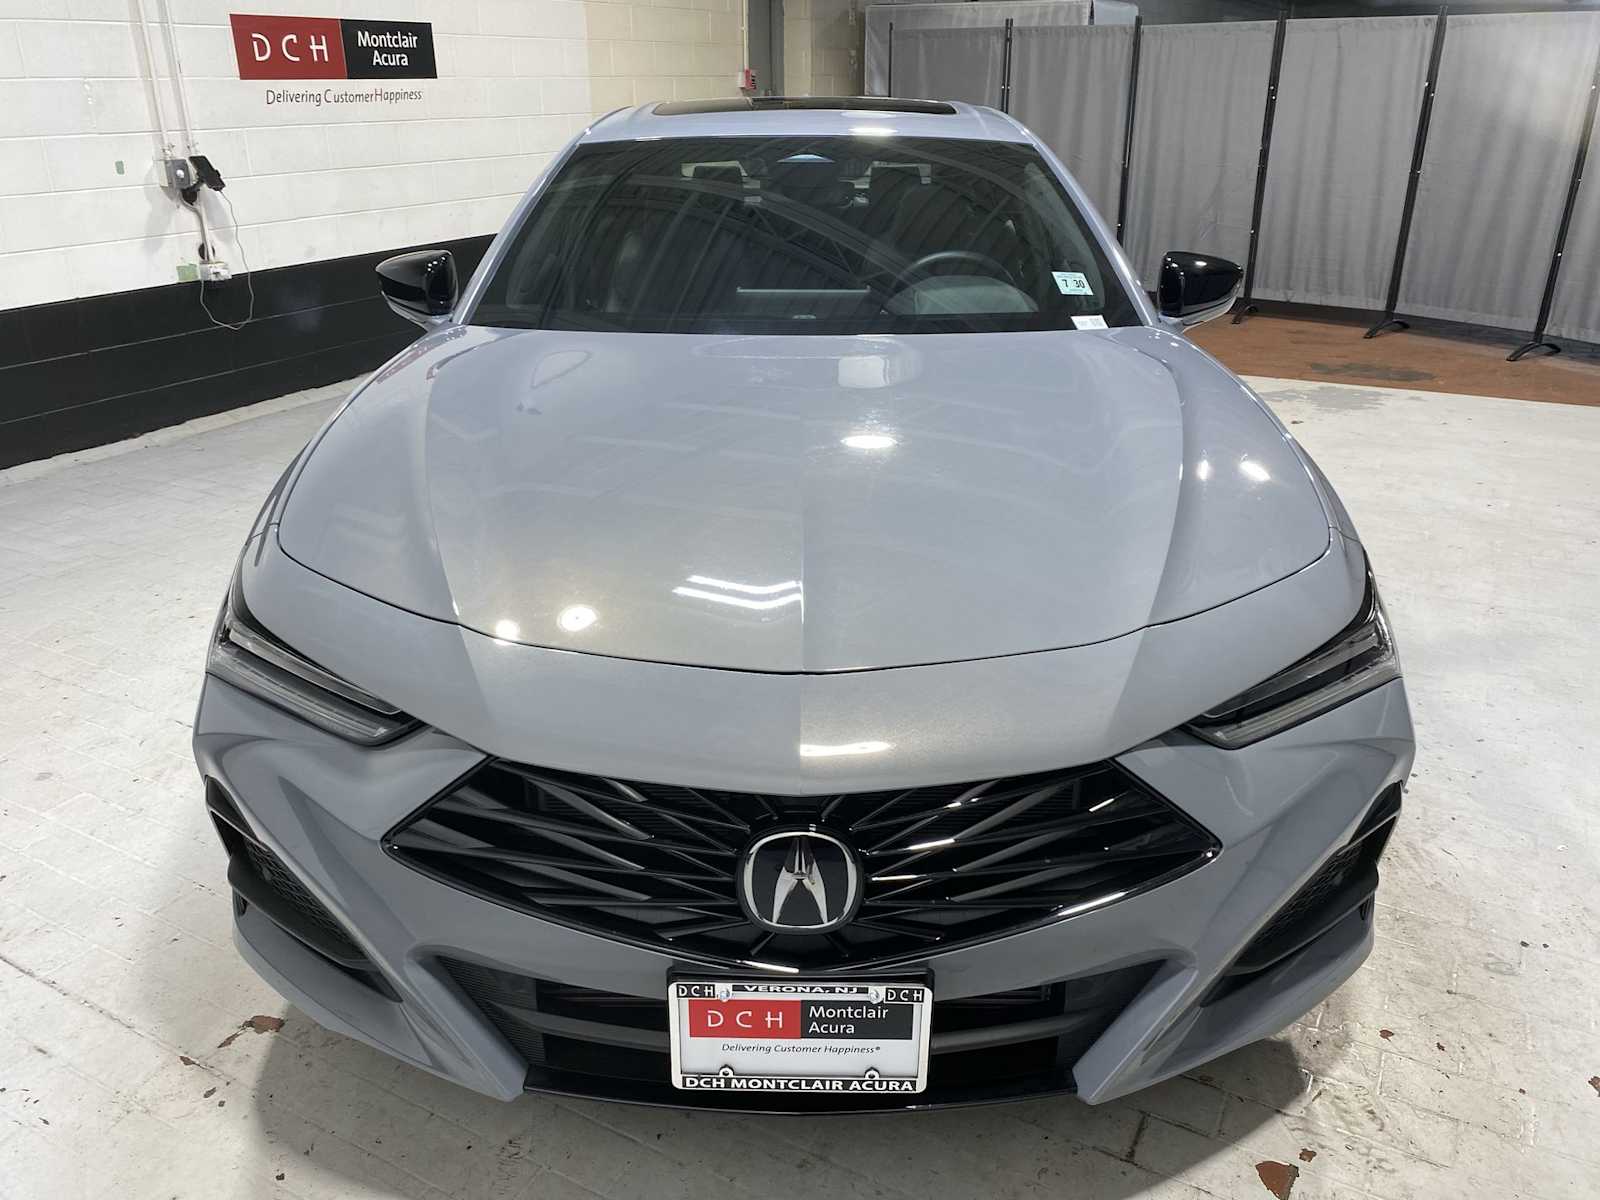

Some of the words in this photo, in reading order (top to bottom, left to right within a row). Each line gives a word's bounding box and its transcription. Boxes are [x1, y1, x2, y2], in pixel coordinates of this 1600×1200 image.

[357, 31, 418, 48] Montclair
[251, 32, 329, 62] DCH
[372, 51, 409, 66] Acura
[266, 90, 322, 106] Delivering
[324, 89, 374, 104] Customer
[374, 88, 422, 104] Happiness
[1073, 279, 1086, 289] 30
[678, 986, 715, 998] DCH
[744, 985, 830, 993] VERONA,
[837, 986, 858, 994] NJ
[887, 990, 924, 1001] DCH
[707, 1010, 783, 1028] DCH
[809, 1006, 889, 1019] Montclair
[809, 1022, 855, 1034] Acura
[722, 1043, 771, 1053] Delivering
[774, 1044, 821, 1053] Customer
[685, 1077, 725, 1088] DCH
[730, 1078, 843, 1090] MONTCLAIR
[849, 1080, 913, 1091] ACURA
